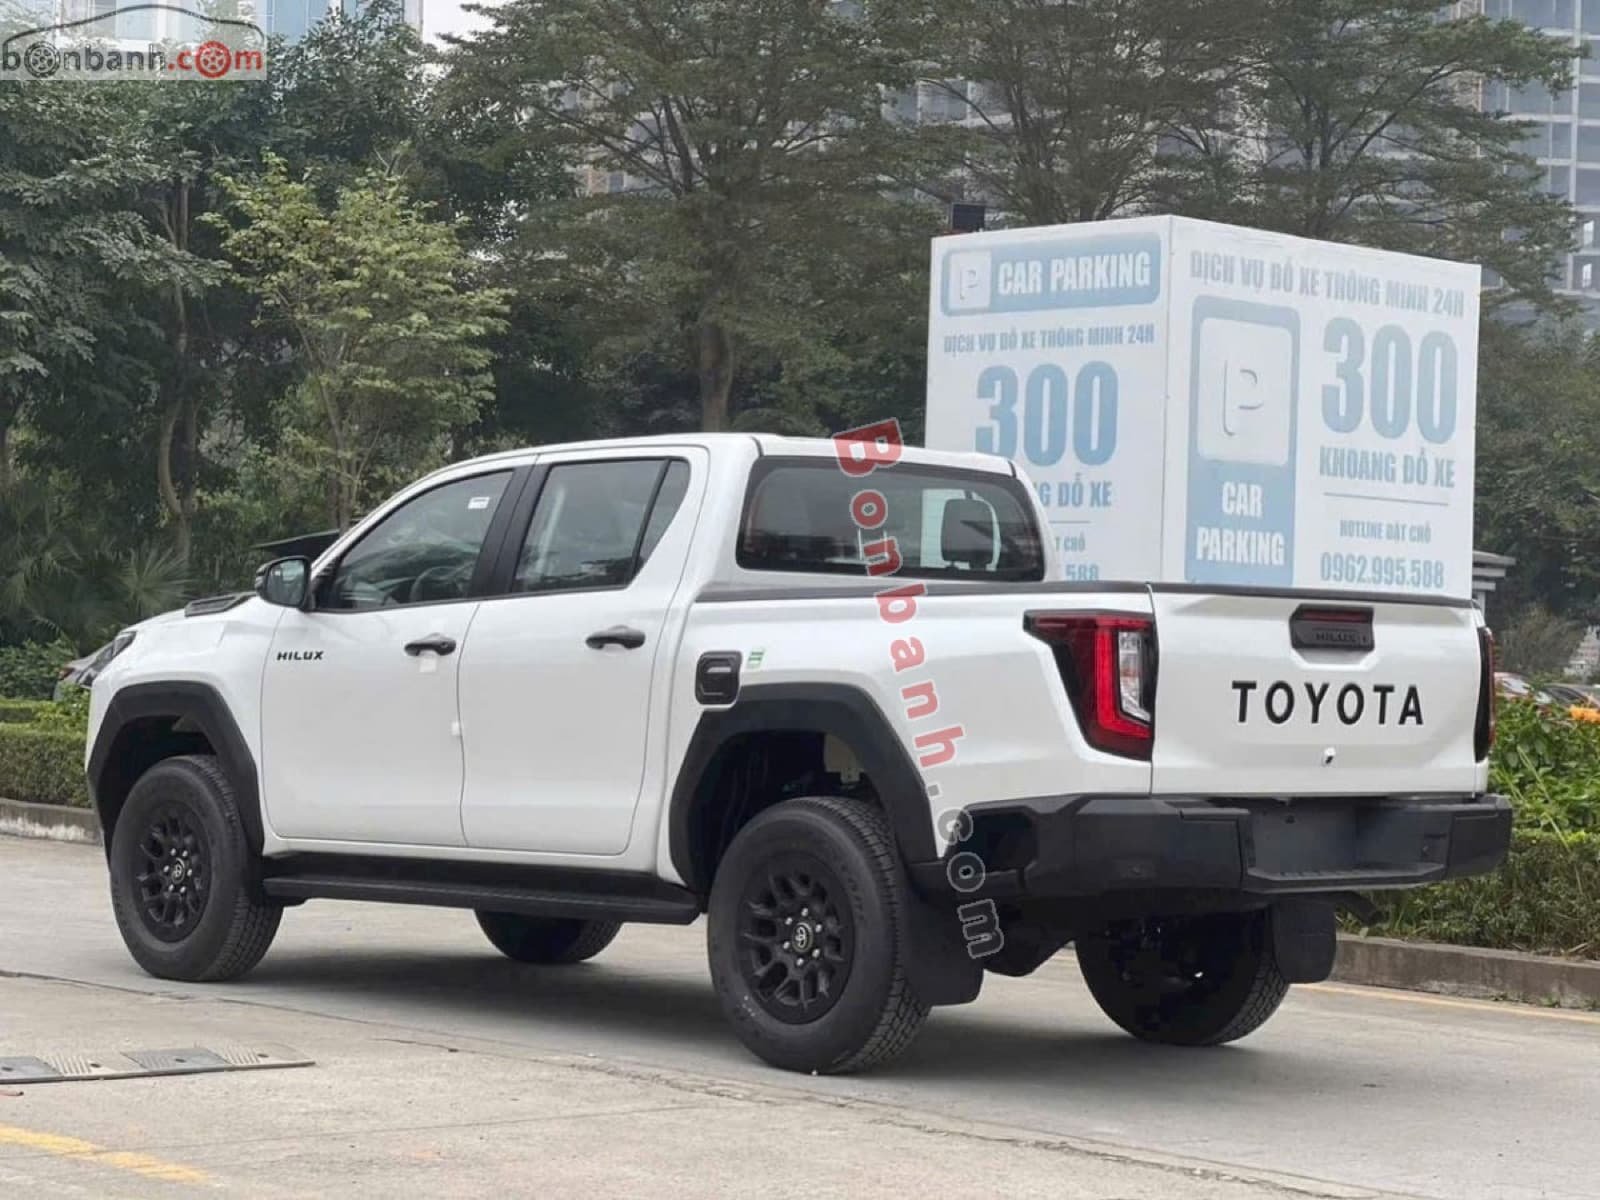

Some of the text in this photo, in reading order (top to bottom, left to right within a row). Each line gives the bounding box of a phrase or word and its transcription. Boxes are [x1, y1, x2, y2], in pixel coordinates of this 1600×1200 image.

[998, 251, 1151, 296] CAR PARKING
[1189, 249, 1235, 285] DỊCH
[1240, 255, 1265, 294] VỤ
[1299, 266, 1320, 297] XE
[1323, 268, 1381, 305] THÔNG
[1385, 278, 1429, 314] MINH
[1433, 286, 1465, 318] 24H
[1021, 330, 1036, 350] XE
[1087, 325, 1124, 346] MINH
[1127, 323, 1155, 345] 24H
[1321, 316, 1458, 445] 300
[975, 361, 1119, 467] 300
[1319, 444, 1397, 484] KHOANG
[1434, 457, 1455, 488] XE
[1089, 479, 1113, 507] XE
[1221, 481, 1263, 517] CAR
[1196, 526, 1285, 566] PARKING
[1339, 519, 1384, 541] HOTLINE
[1320, 551, 1445, 589] 0962.995.588
[276, 650, 325, 661] HILUX
[1231, 680, 1424, 726] TOYOTA
